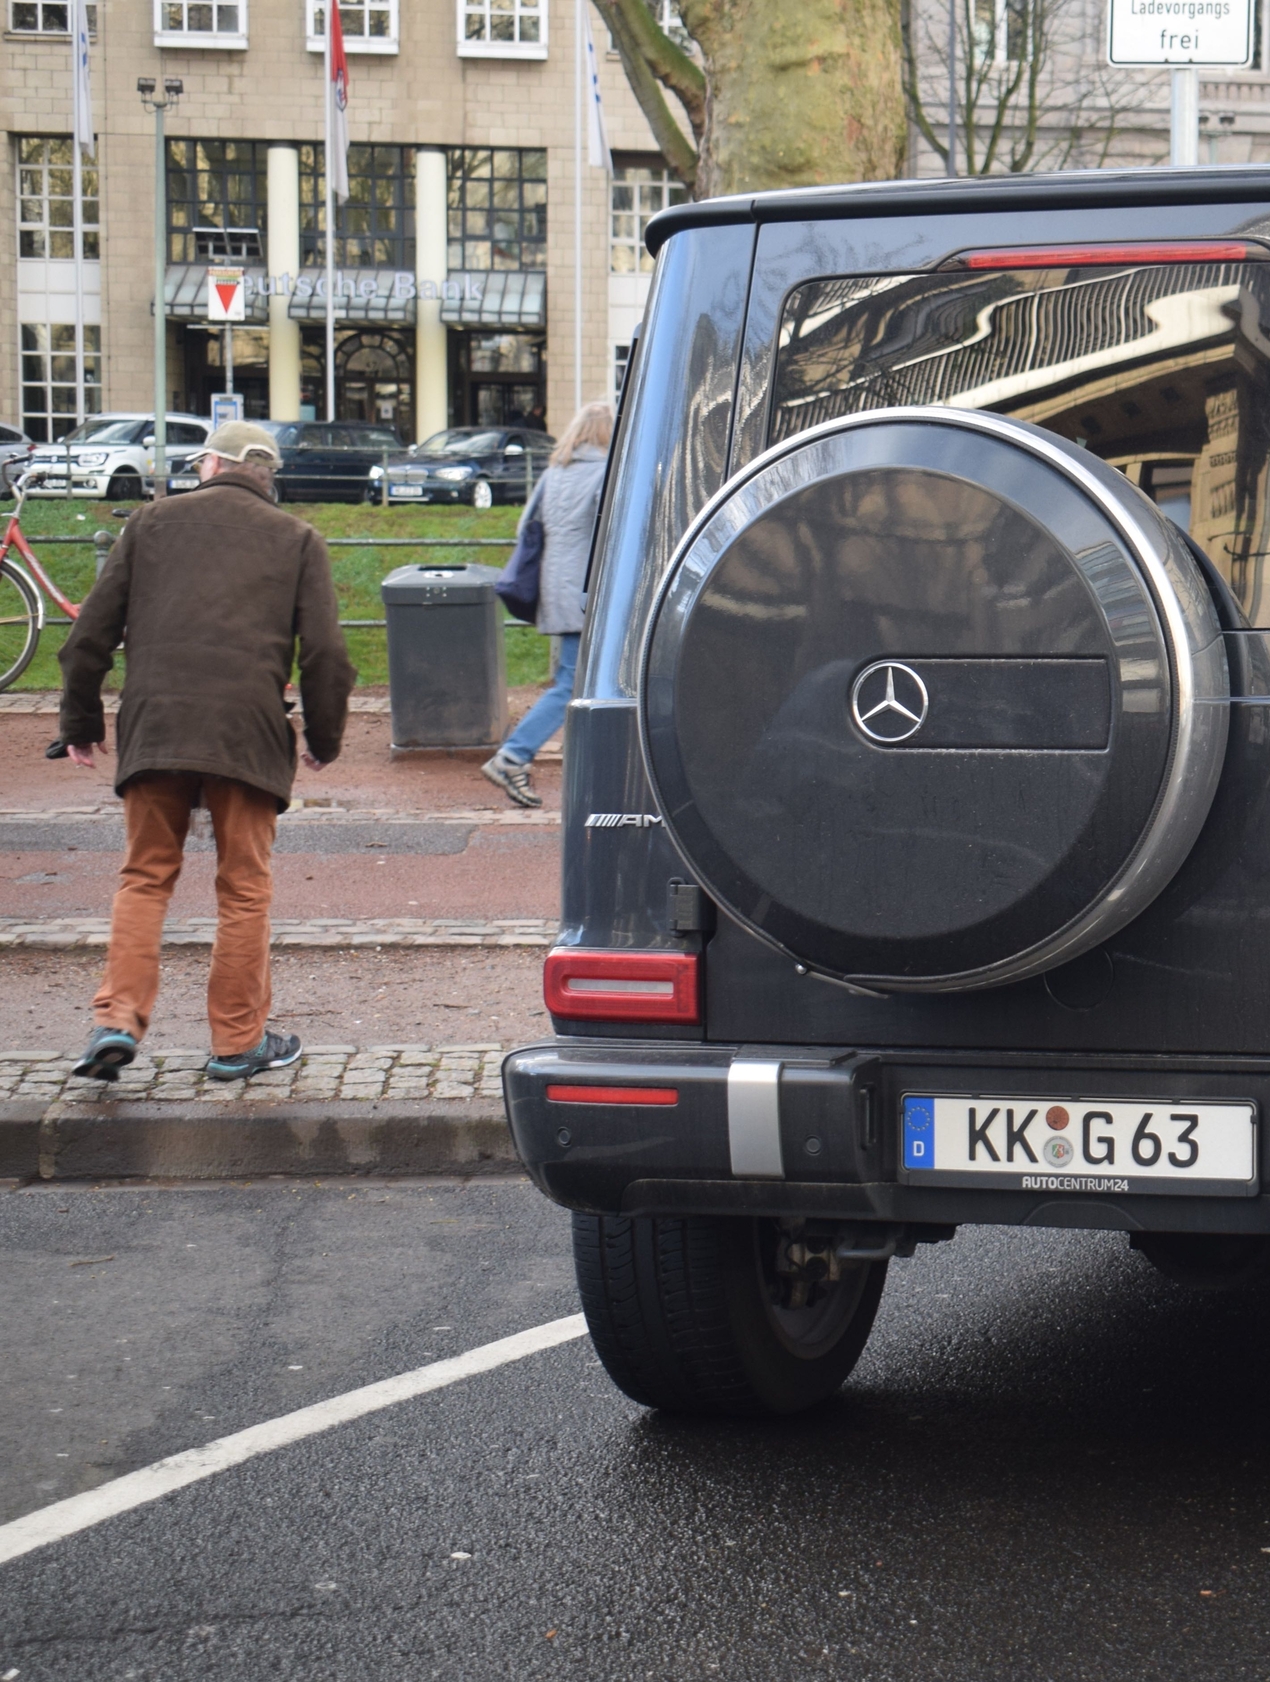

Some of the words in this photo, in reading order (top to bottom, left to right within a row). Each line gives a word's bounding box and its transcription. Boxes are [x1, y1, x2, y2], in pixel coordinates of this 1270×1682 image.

[1131, 0, 1231, 19] Ladevorgangs
[1160, 29, 1200, 50] frei
[394, 271, 484, 300] Bank
[616, 813, 667, 828] AM
[968, 1107, 1040, 1164] KK
[1082, 1110, 1115, 1165] G
[1131, 1112, 1200, 1168] 63
[913, 1141, 925, 1157] D
[1022, 1175, 1130, 1192] AUTOCENTRUM24
